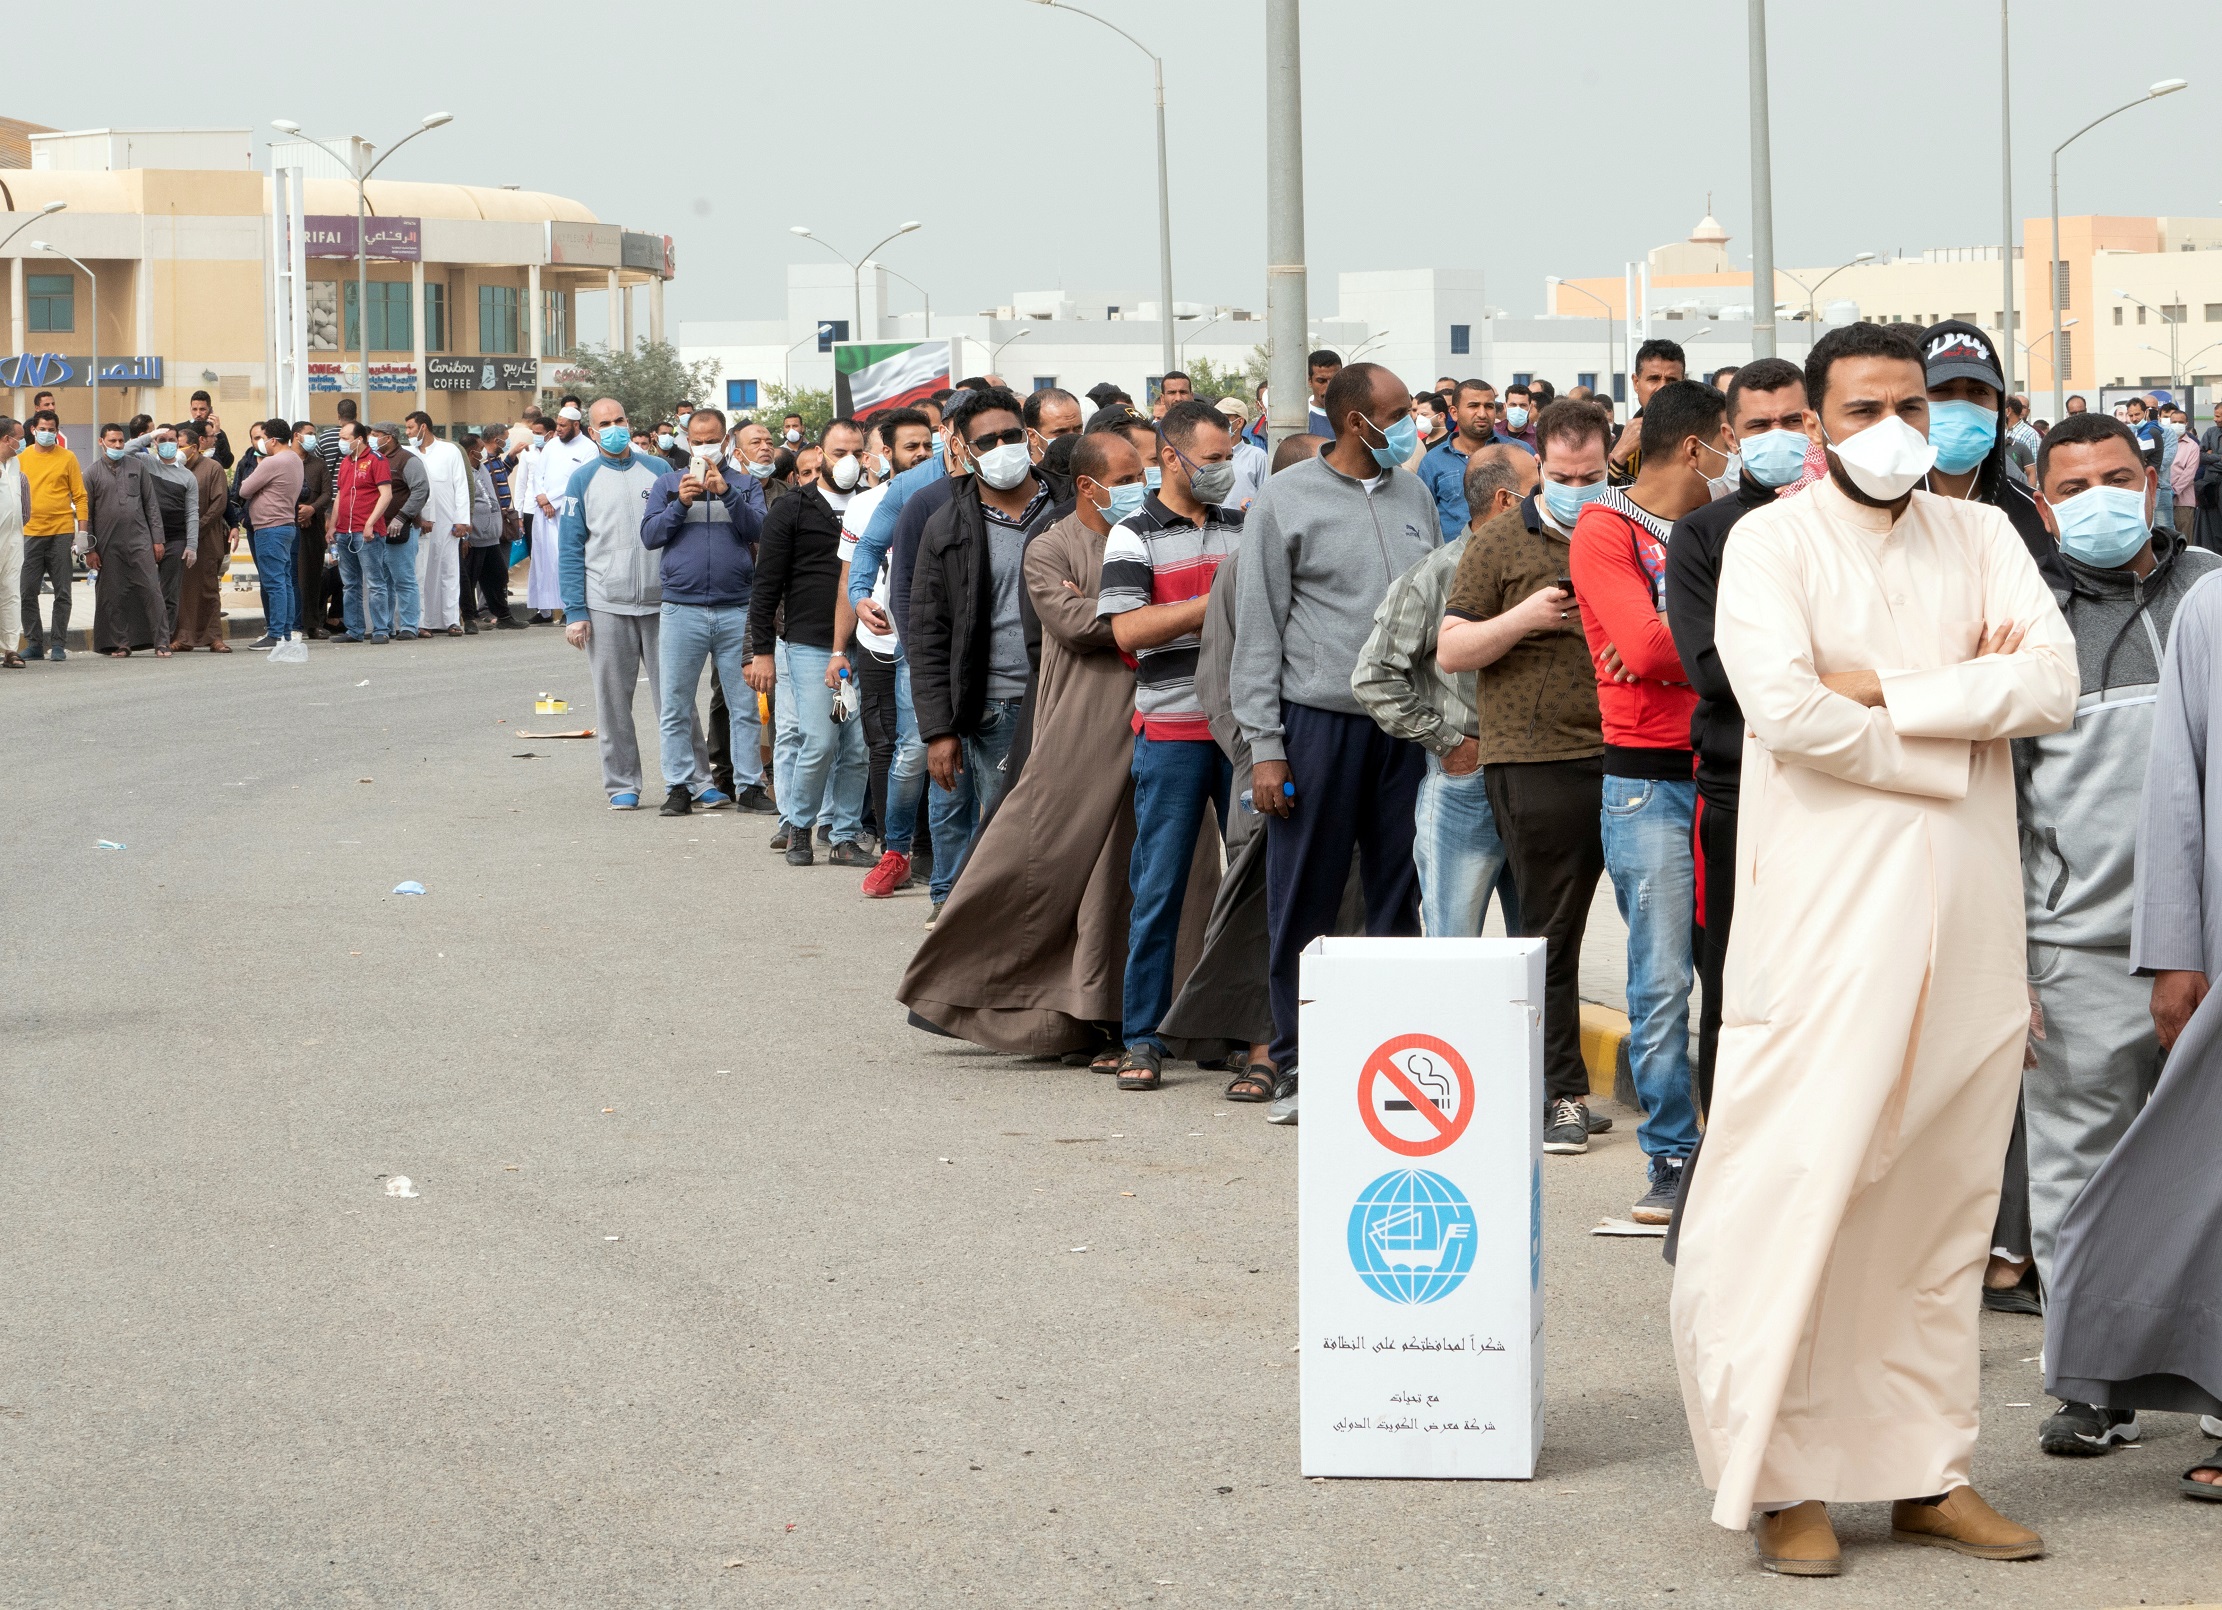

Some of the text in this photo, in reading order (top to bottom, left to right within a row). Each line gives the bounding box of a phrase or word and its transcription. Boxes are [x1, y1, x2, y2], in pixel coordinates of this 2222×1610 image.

[364, 231, 417, 246] الرفاعي
[86, 356, 161, 387] النصر
[428, 358, 475, 374] Caribou
[433, 378, 471, 389] COFFEE
[1324, 1336, 1365, 1350] النظافة
[1372, 1337, 1395, 1353] على
[1402, 1336, 1464, 1351] لمحافظتكم
[1390, 1391, 1439, 1407] مع تحيات
[1333, 1417, 1495, 1434] شركة معرض الكويت الدولي
